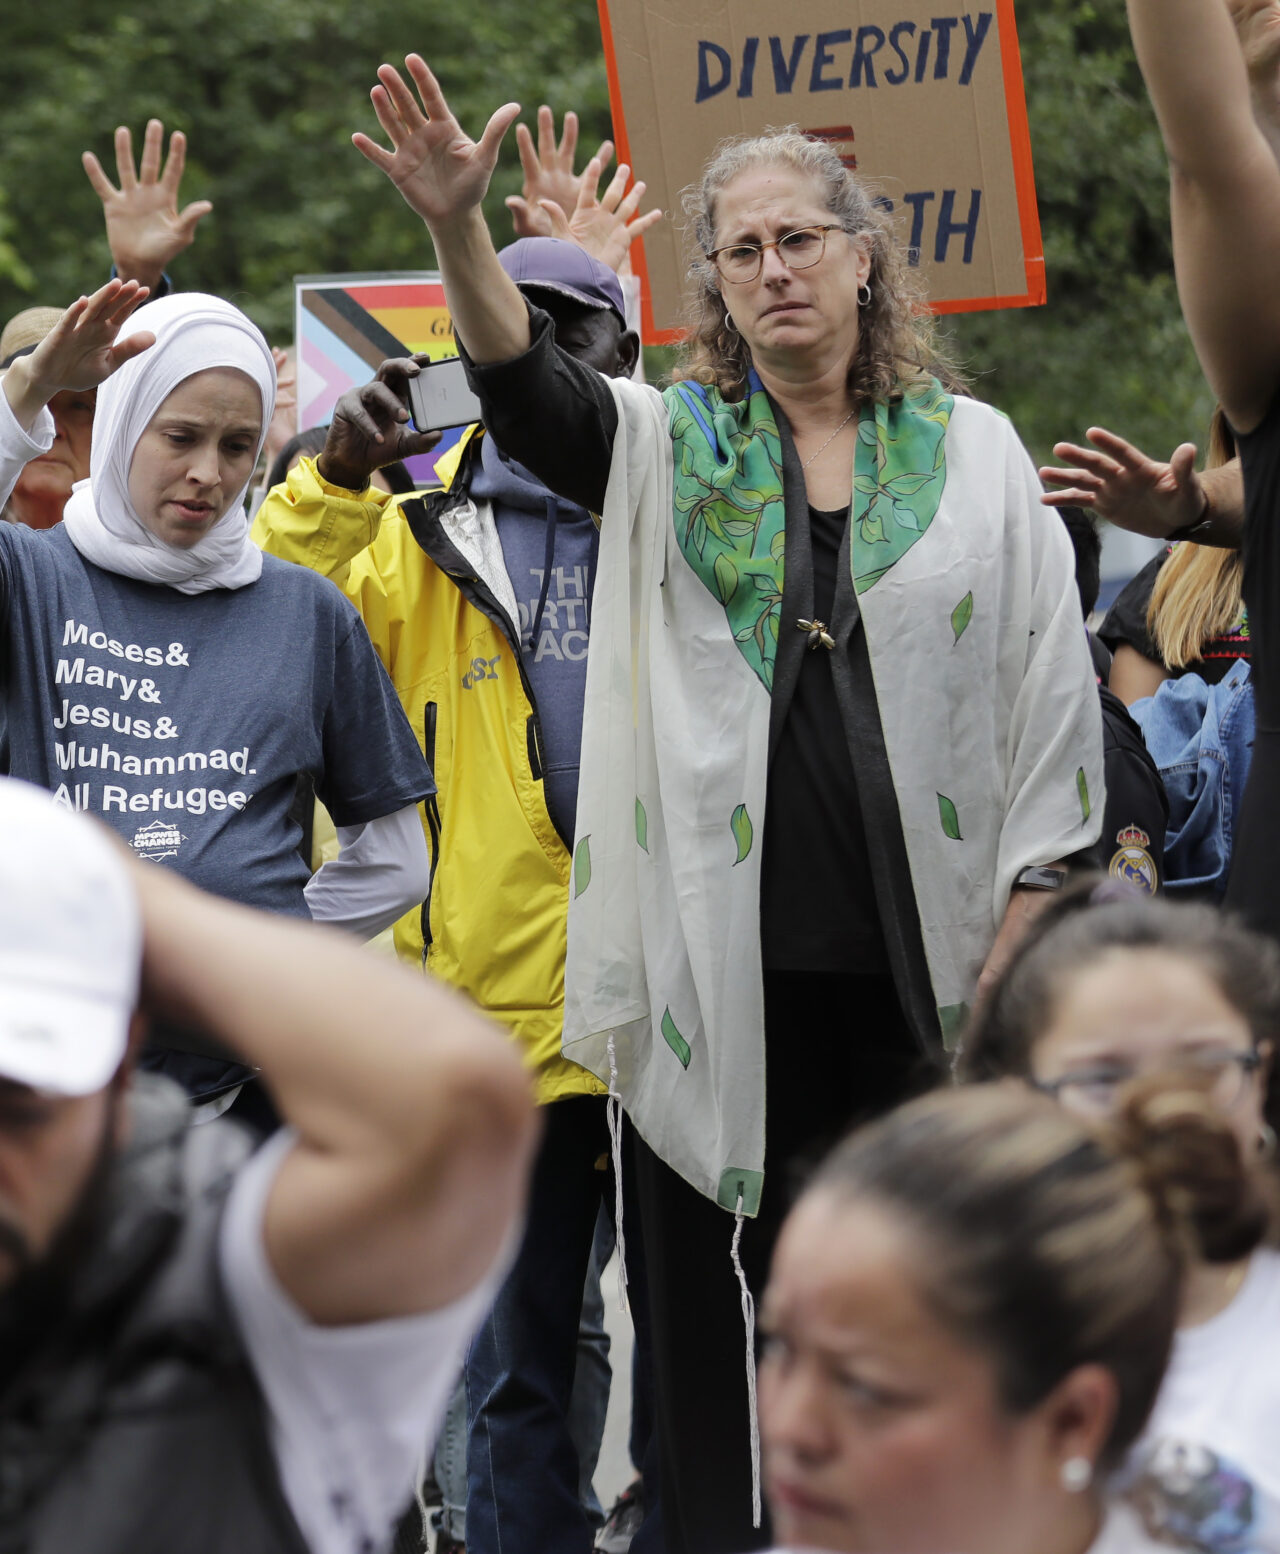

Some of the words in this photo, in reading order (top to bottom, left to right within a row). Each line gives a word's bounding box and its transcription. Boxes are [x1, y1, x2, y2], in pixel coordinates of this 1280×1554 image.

[694, 12, 993, 103] DIVERSITY
[62, 619, 190, 667] Moses&
[54, 657, 162, 704] Mary&
[53, 699, 179, 740] Jesus&
[54, 740, 257, 777] Muhammad.
[51, 782, 90, 812] All
[102, 785, 253, 815] Refugee
[133, 836, 181, 848] CHANGE
